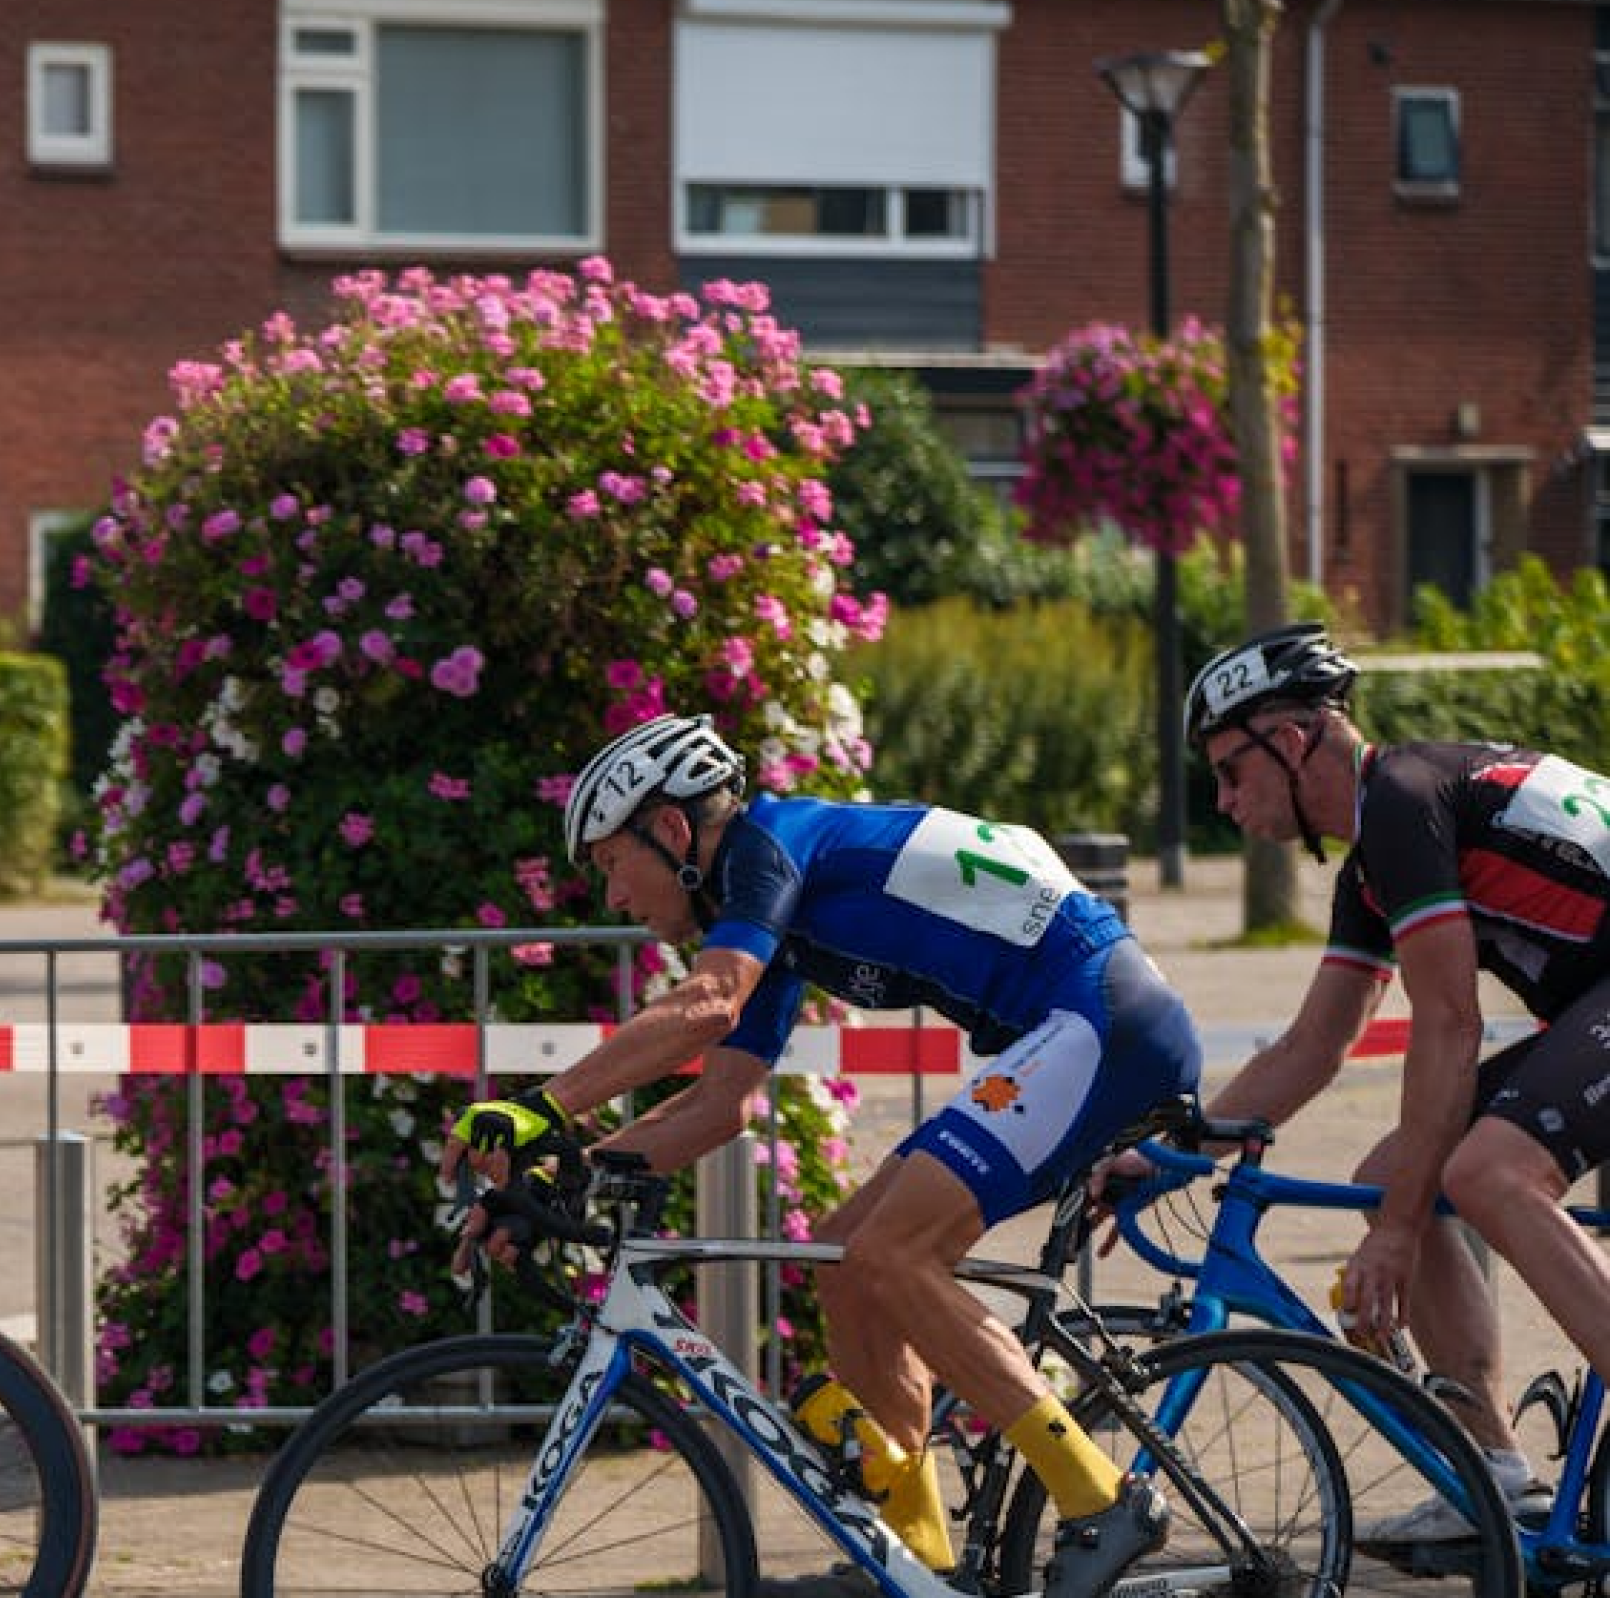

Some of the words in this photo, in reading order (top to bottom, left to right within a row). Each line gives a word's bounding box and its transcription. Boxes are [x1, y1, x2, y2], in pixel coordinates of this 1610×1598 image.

[1217, 662, 1253, 699] 22
[604, 760, 646, 798] 12
[521, 1371, 604, 1511] KOGA
